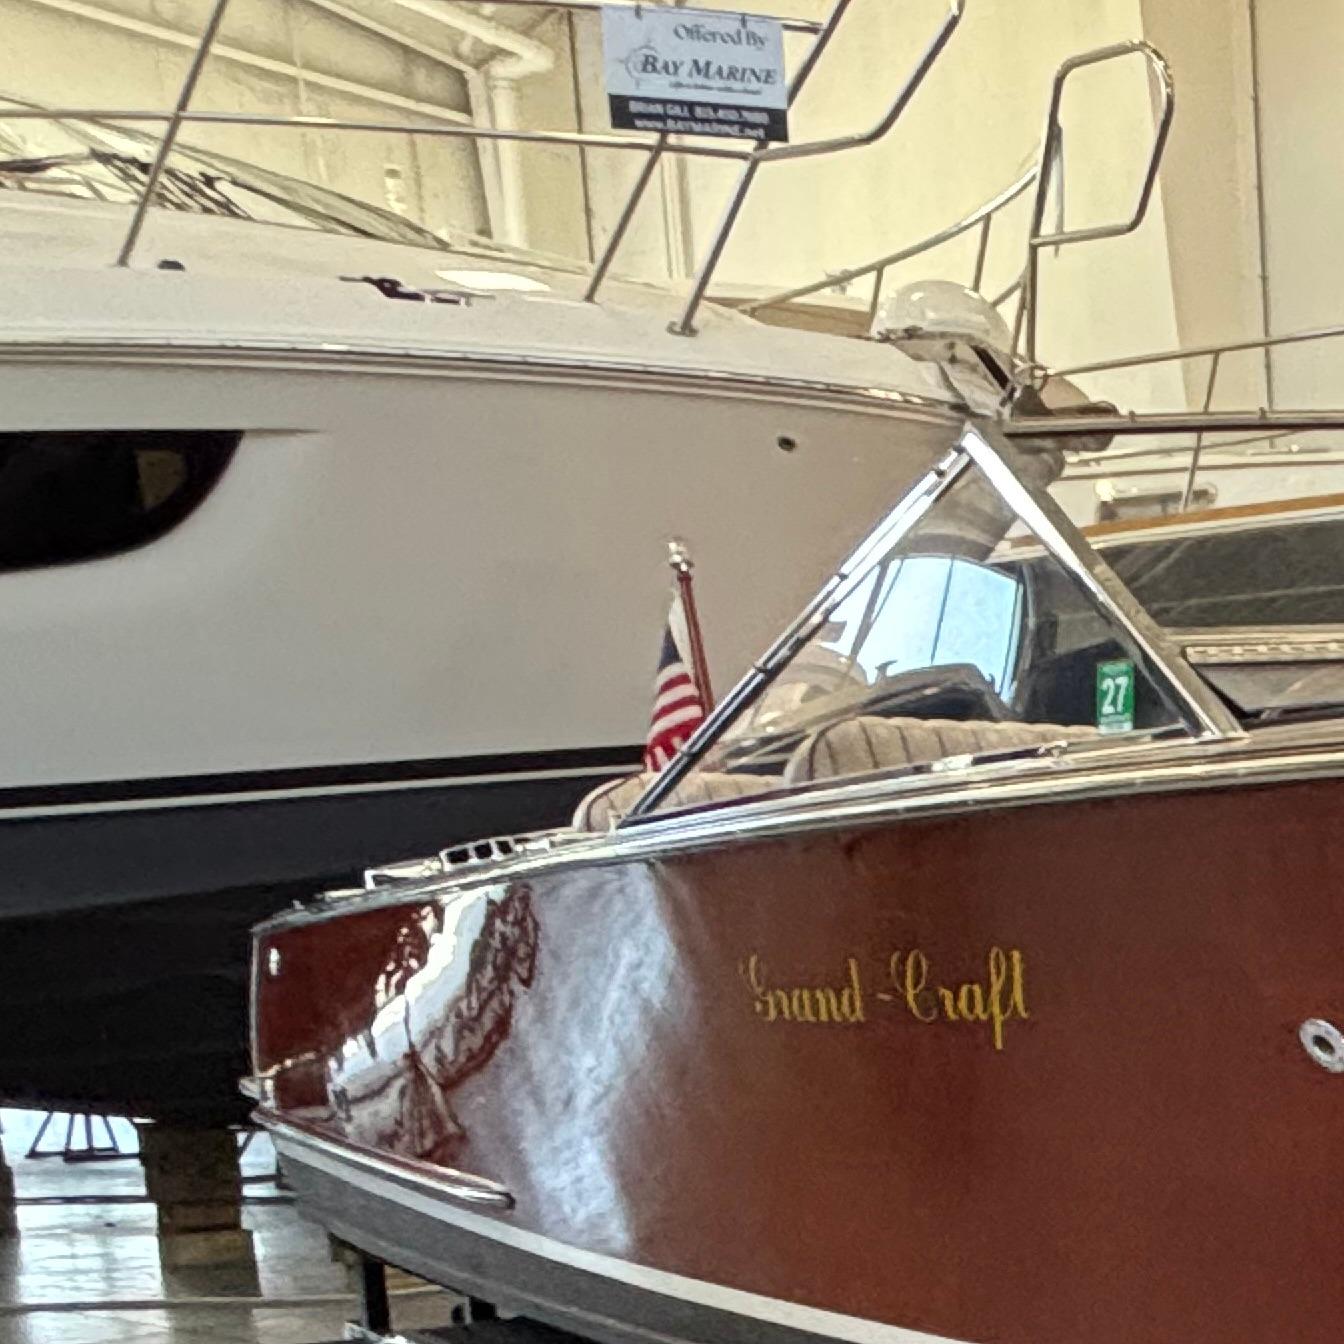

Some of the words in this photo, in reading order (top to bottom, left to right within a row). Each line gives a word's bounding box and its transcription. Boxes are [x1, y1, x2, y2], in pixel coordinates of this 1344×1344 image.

[673, 23, 742, 47] Offered
[746, 31, 768, 49] By
[641, 54, 684, 77] BAY
[688, 58, 778, 86] MARINE
[1101, 676, 1129, 714] 27
